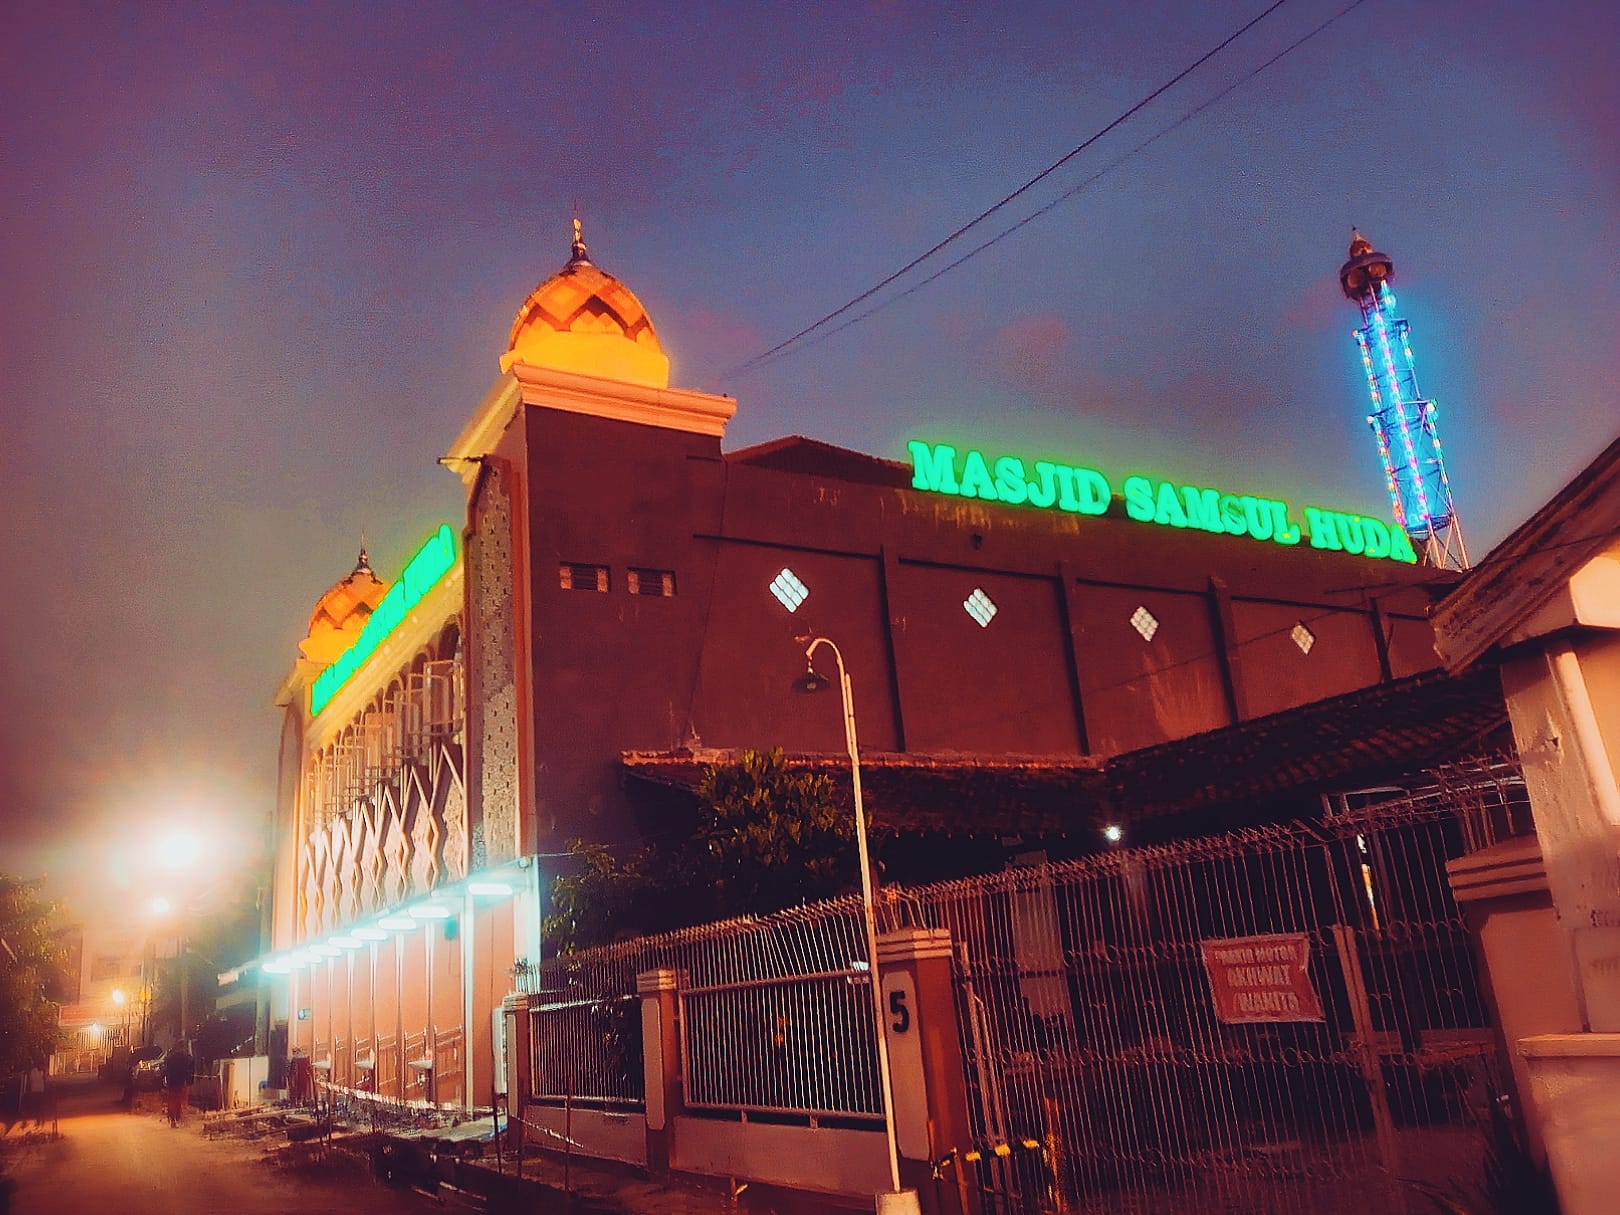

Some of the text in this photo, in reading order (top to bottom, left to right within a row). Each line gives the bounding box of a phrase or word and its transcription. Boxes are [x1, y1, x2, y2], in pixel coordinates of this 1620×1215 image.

[908, 440, 1417, 564] MASJID SAMSUL HUDA
[889, 990, 910, 1033] 5
